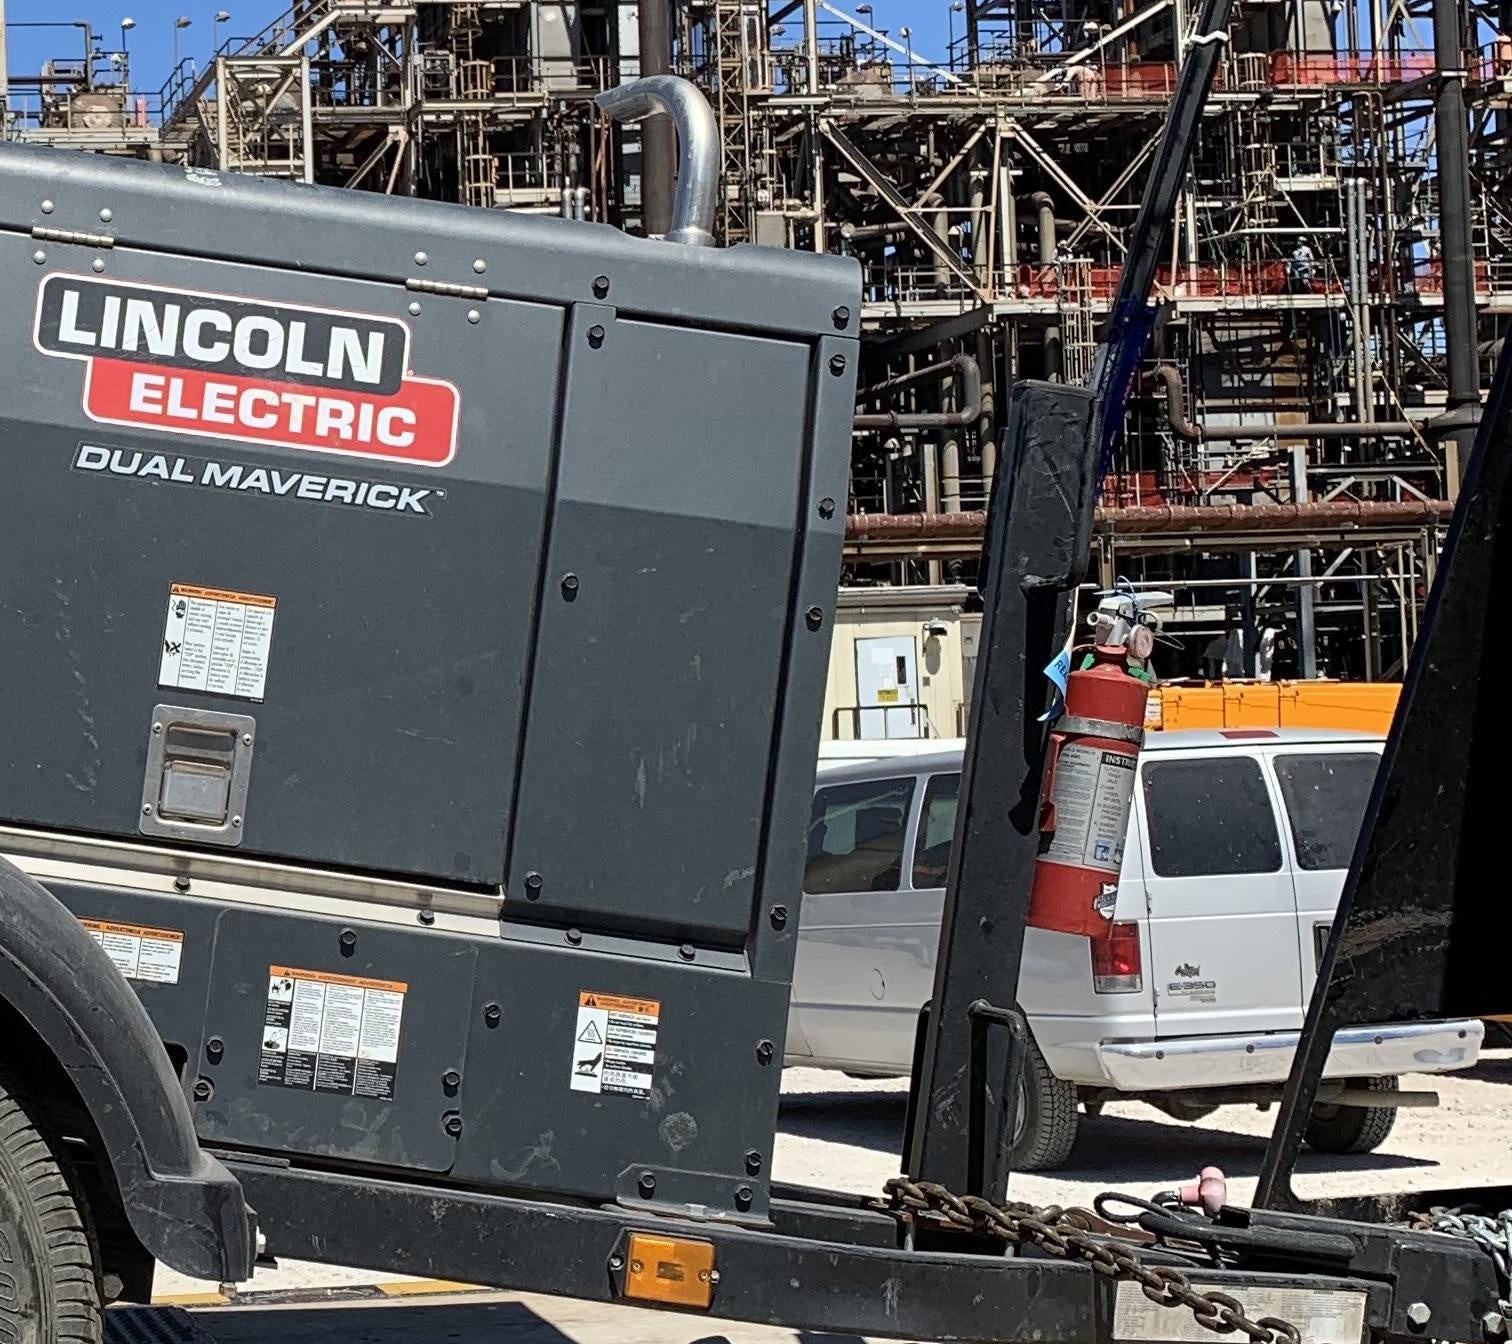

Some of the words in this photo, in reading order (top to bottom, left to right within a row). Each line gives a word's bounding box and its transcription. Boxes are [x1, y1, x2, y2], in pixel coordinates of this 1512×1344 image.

[57, 290, 385, 384] LINCOLN
[129, 375, 417, 447] ELECTRIC
[75, 446, 194, 483] DUAL
[1168, 981, 1216, 991] E-350
